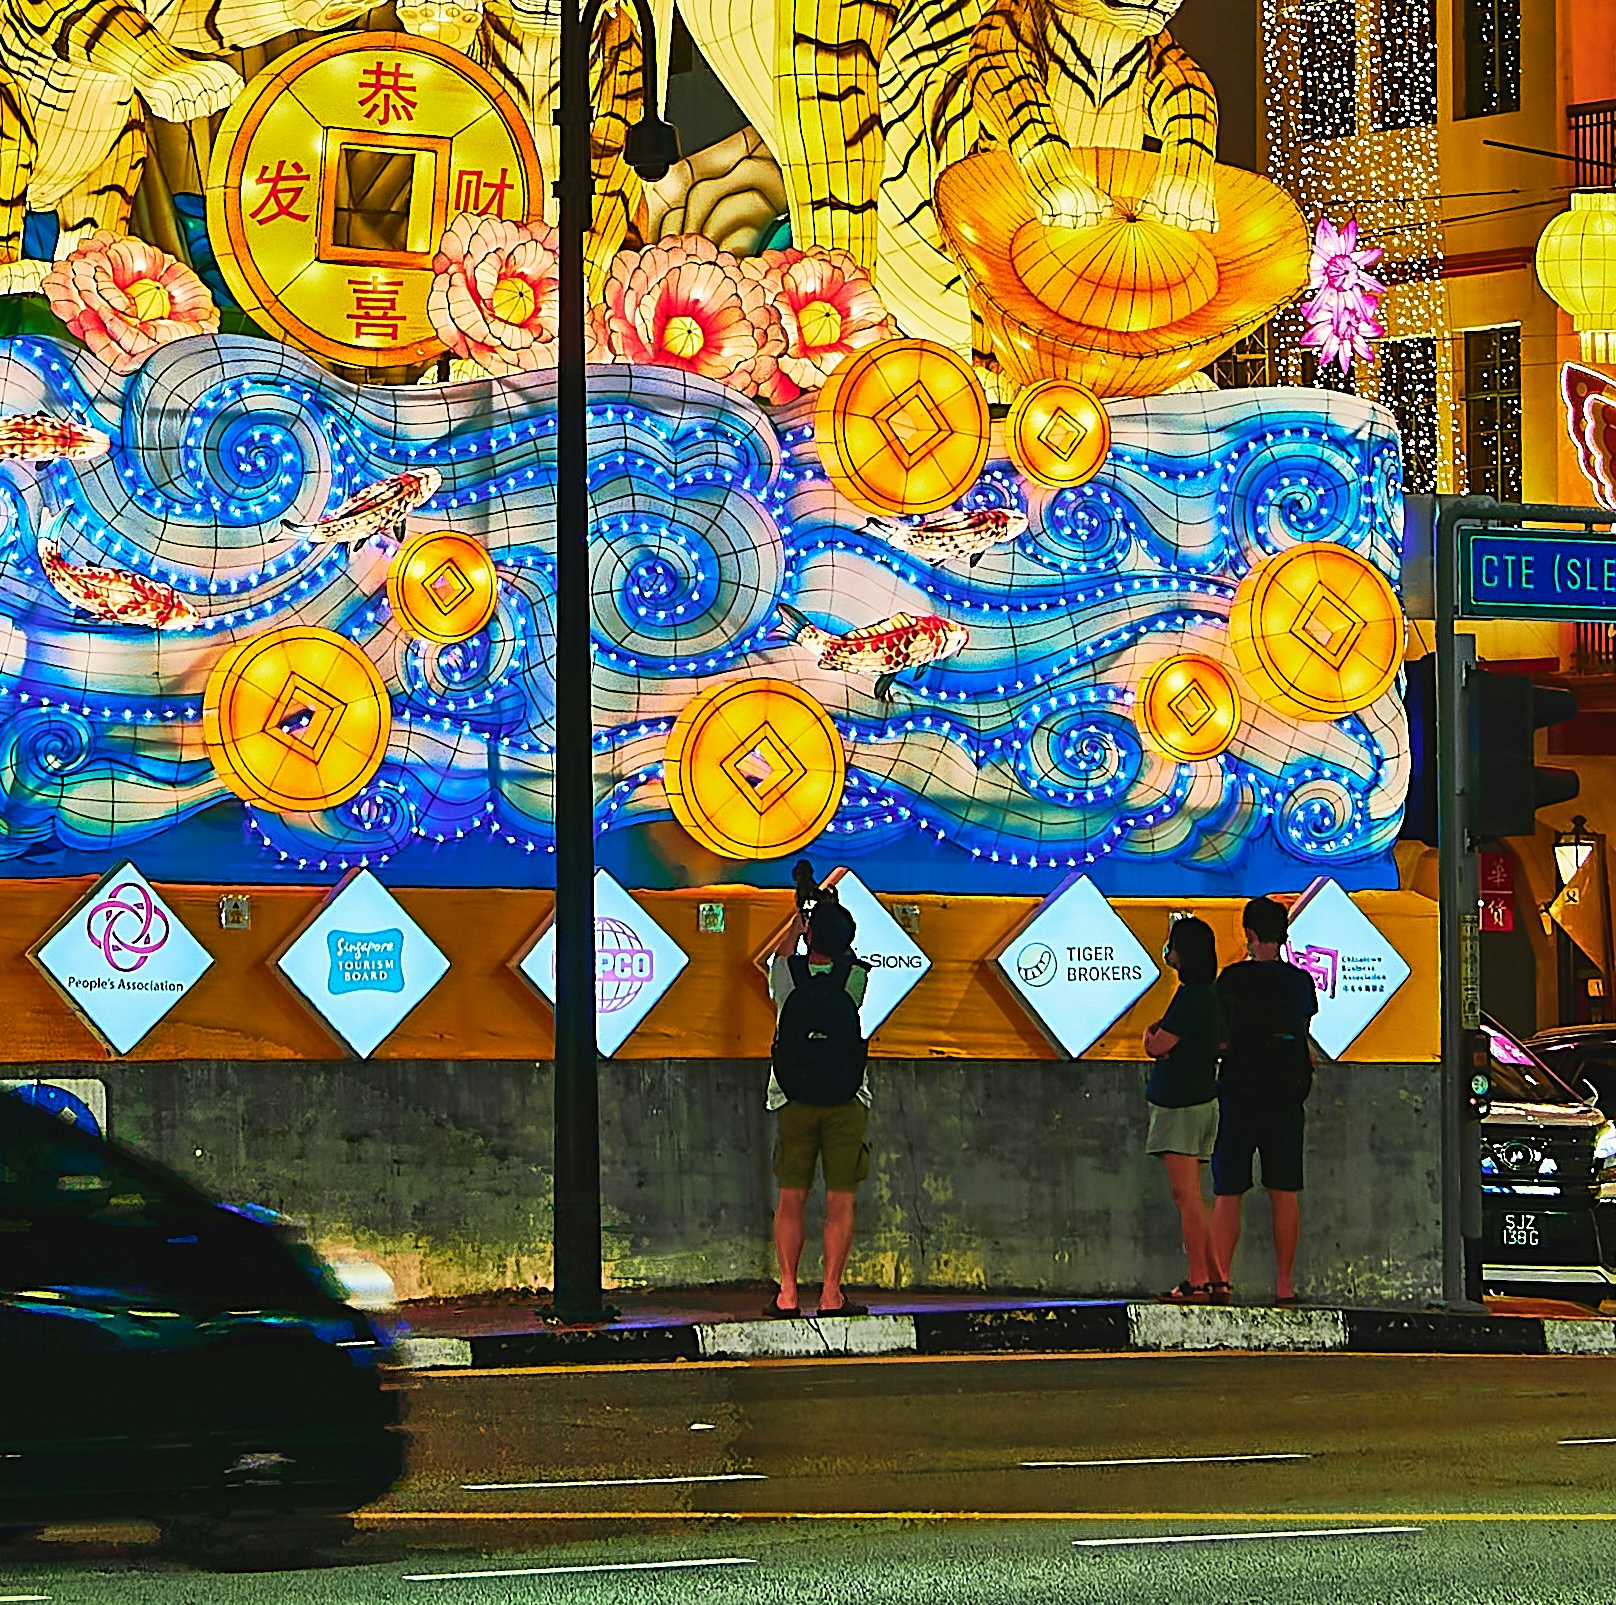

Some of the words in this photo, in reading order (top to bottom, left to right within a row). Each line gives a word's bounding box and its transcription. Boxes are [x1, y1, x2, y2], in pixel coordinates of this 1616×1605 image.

[358, 61, 418, 126] 恭
[249, 160, 311, 226] 发
[454, 168, 515, 220] 财
[346, 275, 407, 341] 喜
[1482, 554, 1534, 590] CTE
[337, 937, 394, 960] Singapore
[1066, 946, 1114, 962] TIGER
[338, 959, 394, 971] TOURISM
[595, 952, 650, 979] PCO
[1067, 965, 1142, 982] BROKERS
[68, 976, 115, 992] People's
[117, 978, 184, 993] Association
[345, 971, 388, 982] BOARD
[1505, 1214, 1536, 1230] SJZ
[1503, 1229, 1539, 1246] 138G
